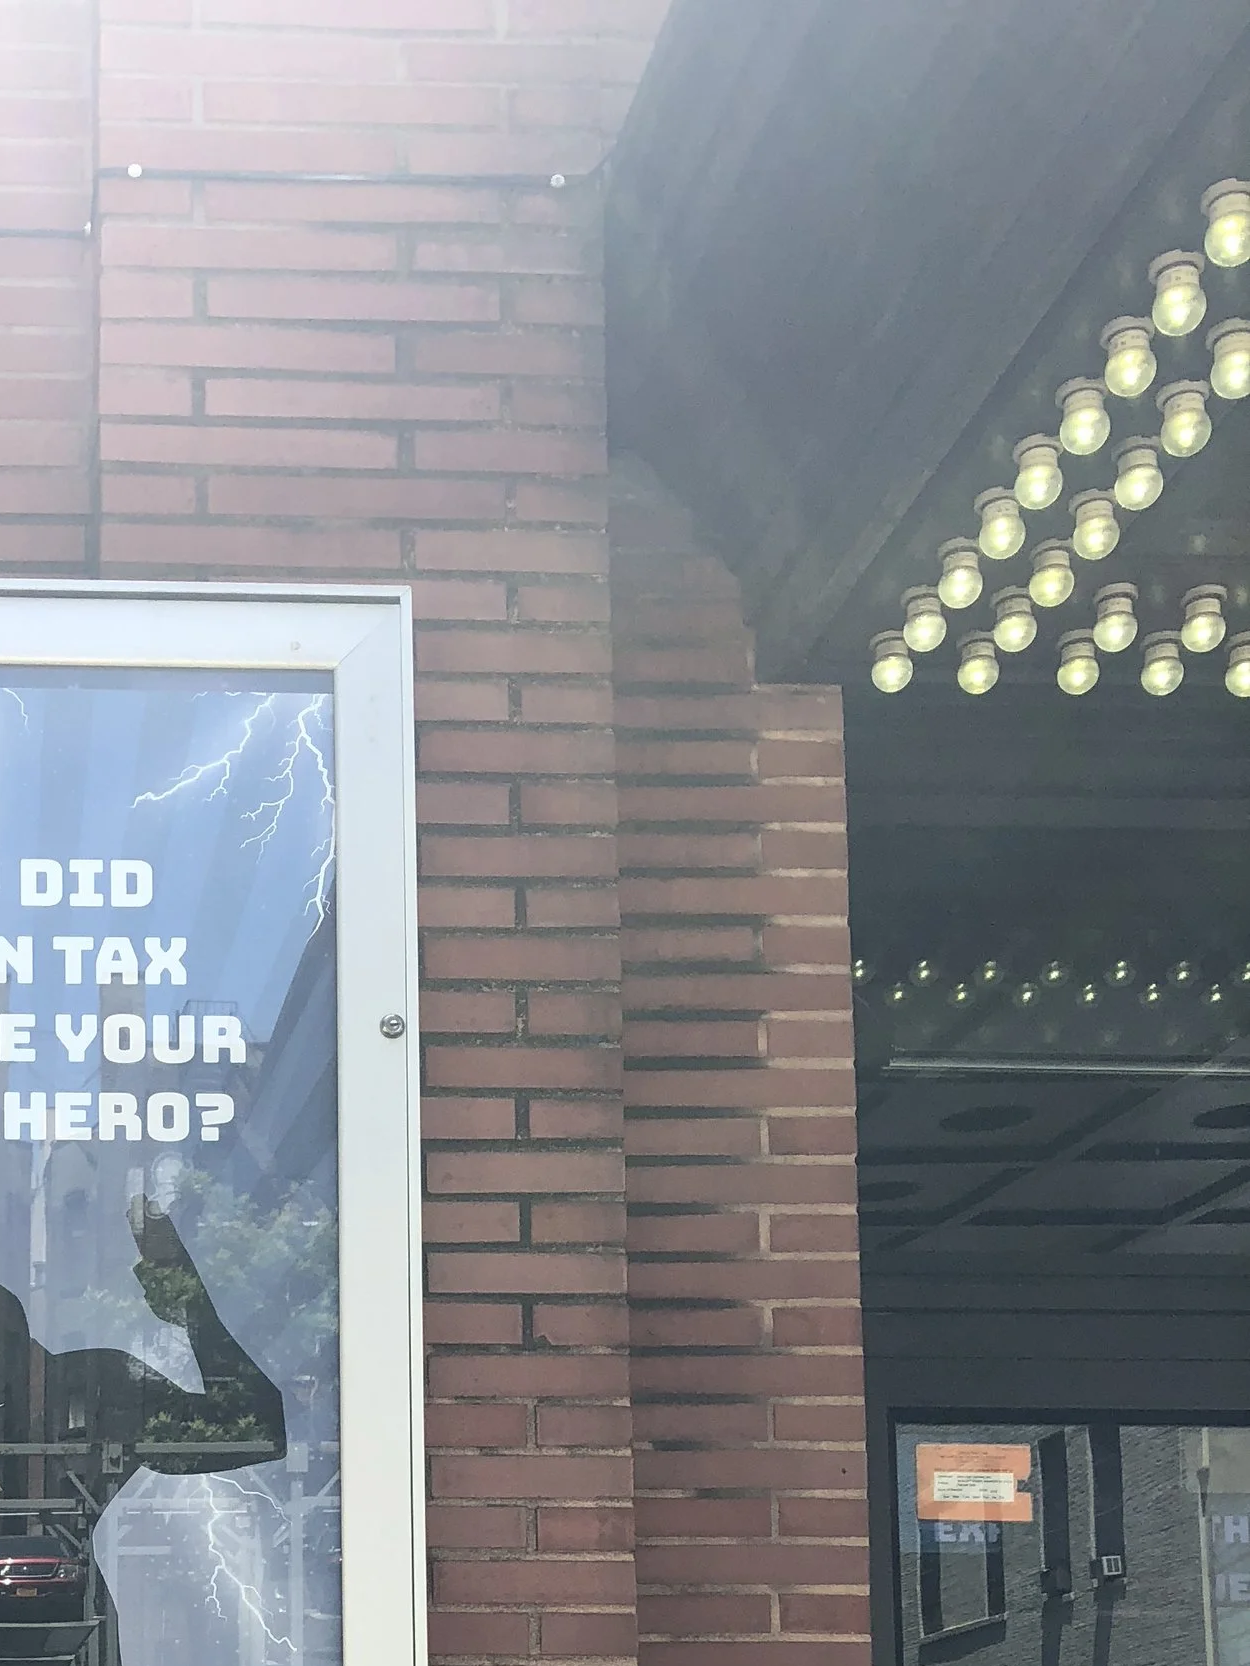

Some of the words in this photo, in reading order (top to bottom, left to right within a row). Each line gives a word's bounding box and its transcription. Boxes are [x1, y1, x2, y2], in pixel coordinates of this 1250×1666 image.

[20, 857, 154, 908] DID
[52, 936, 188, 986] TAX
[55, 1013, 247, 1064] YOUR
